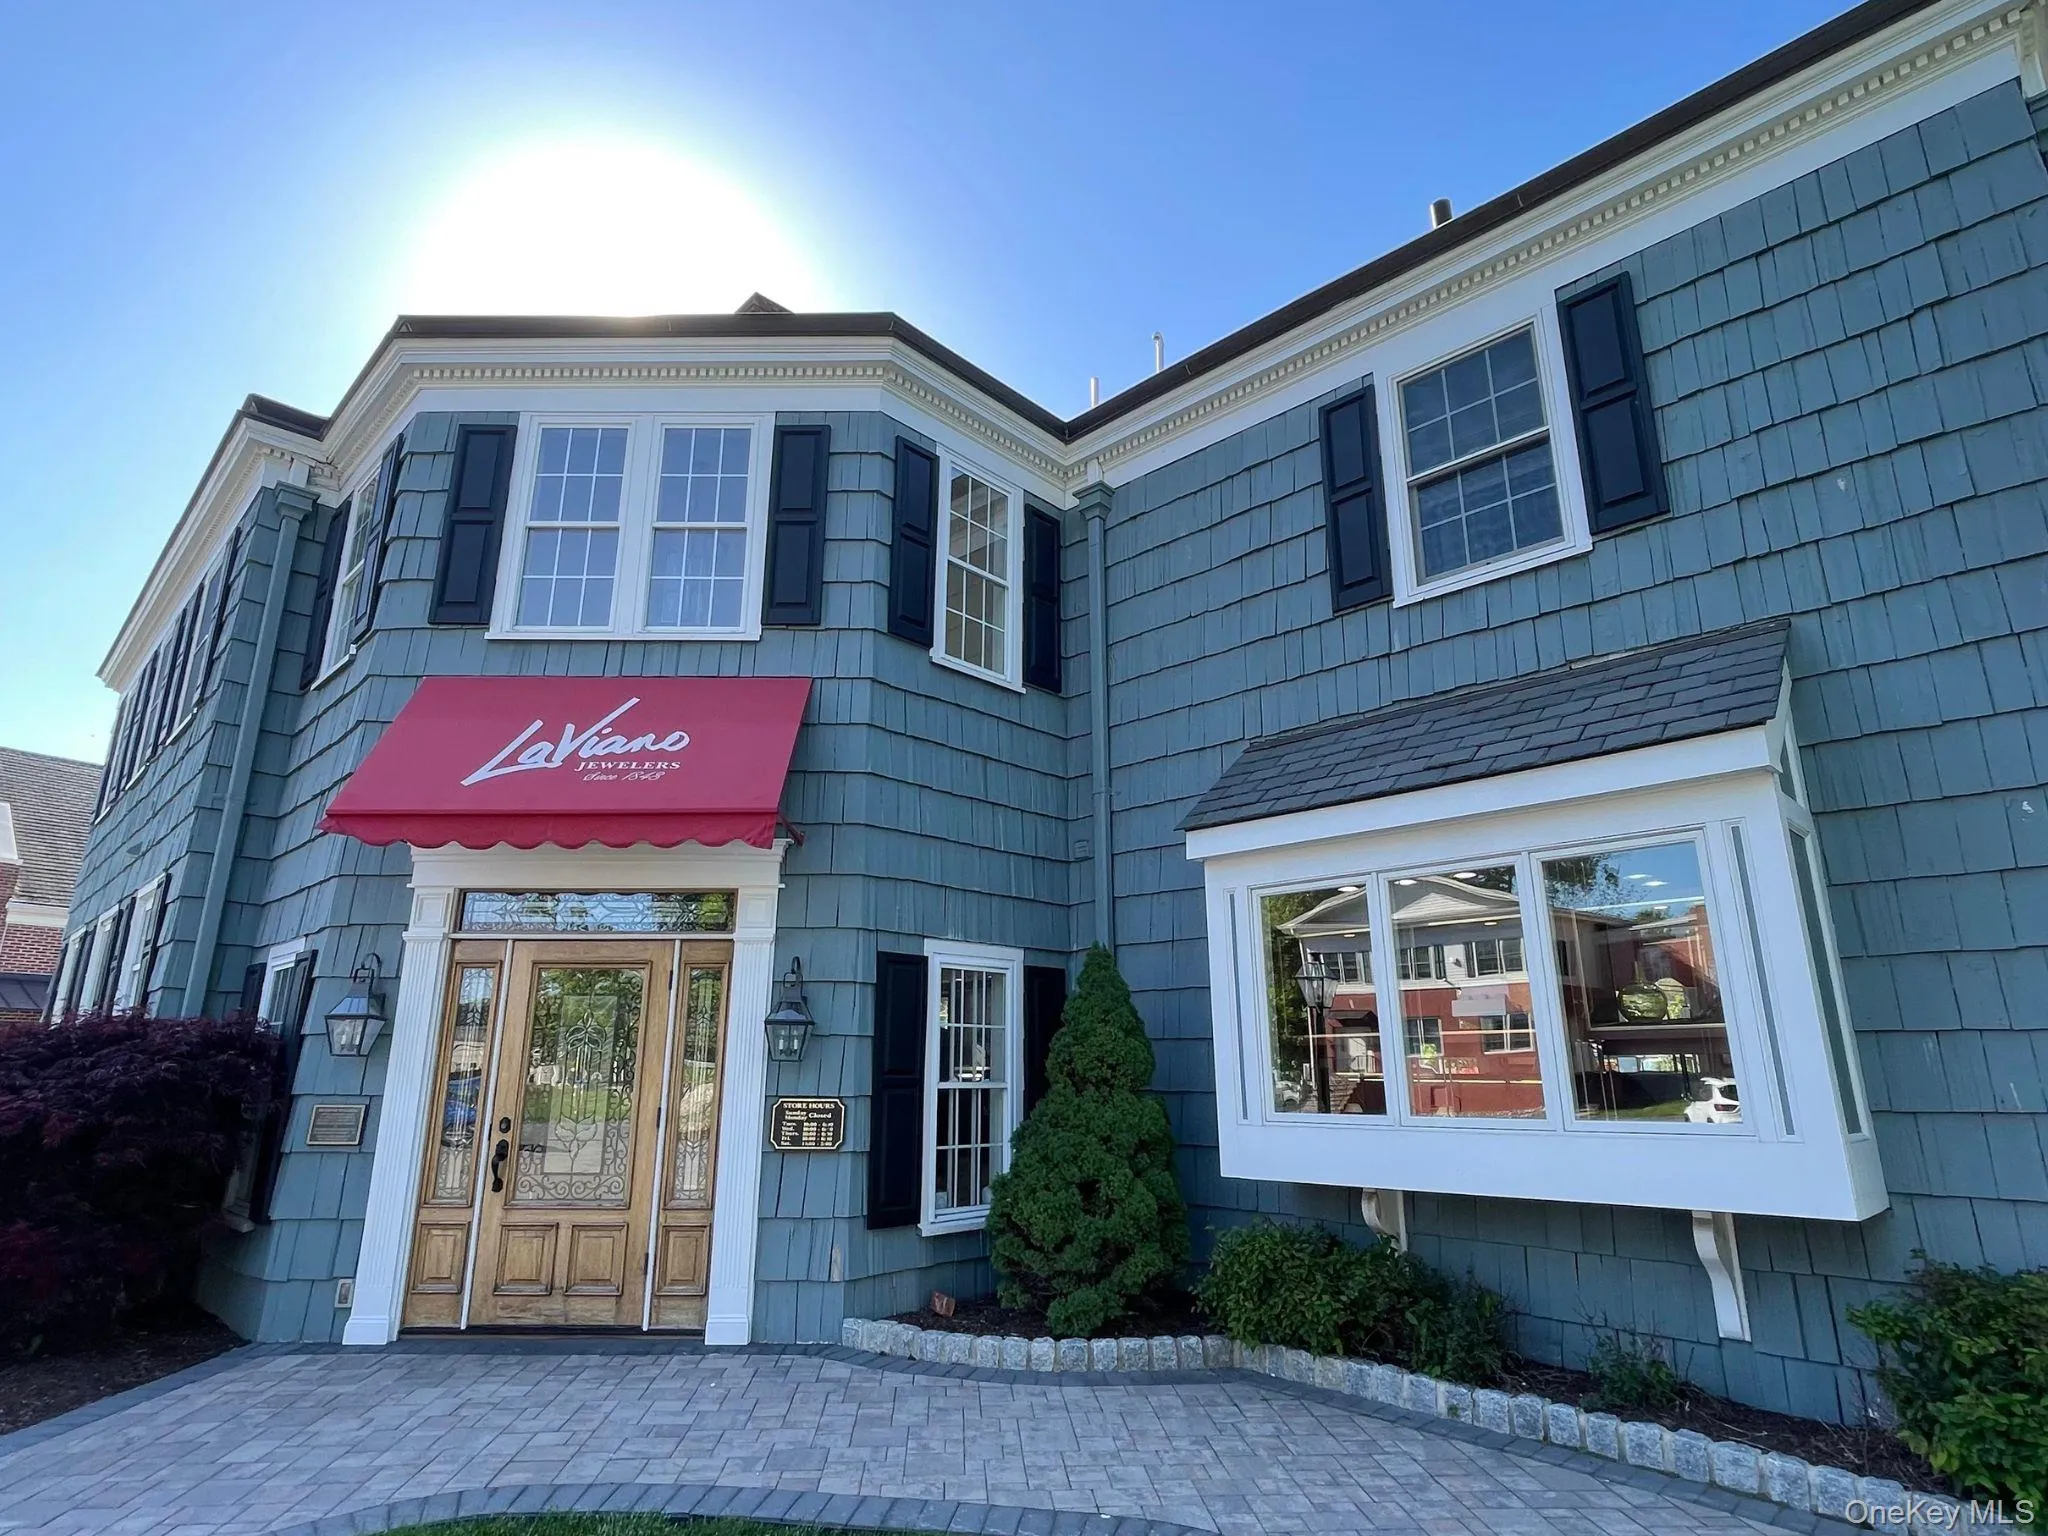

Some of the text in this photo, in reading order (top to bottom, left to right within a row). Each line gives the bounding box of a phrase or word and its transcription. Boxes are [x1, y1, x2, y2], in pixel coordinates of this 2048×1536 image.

[460, 697, 690, 787] LaViano
[574, 761, 681, 772] JEWELERS
[583, 771, 618, 781] Since
